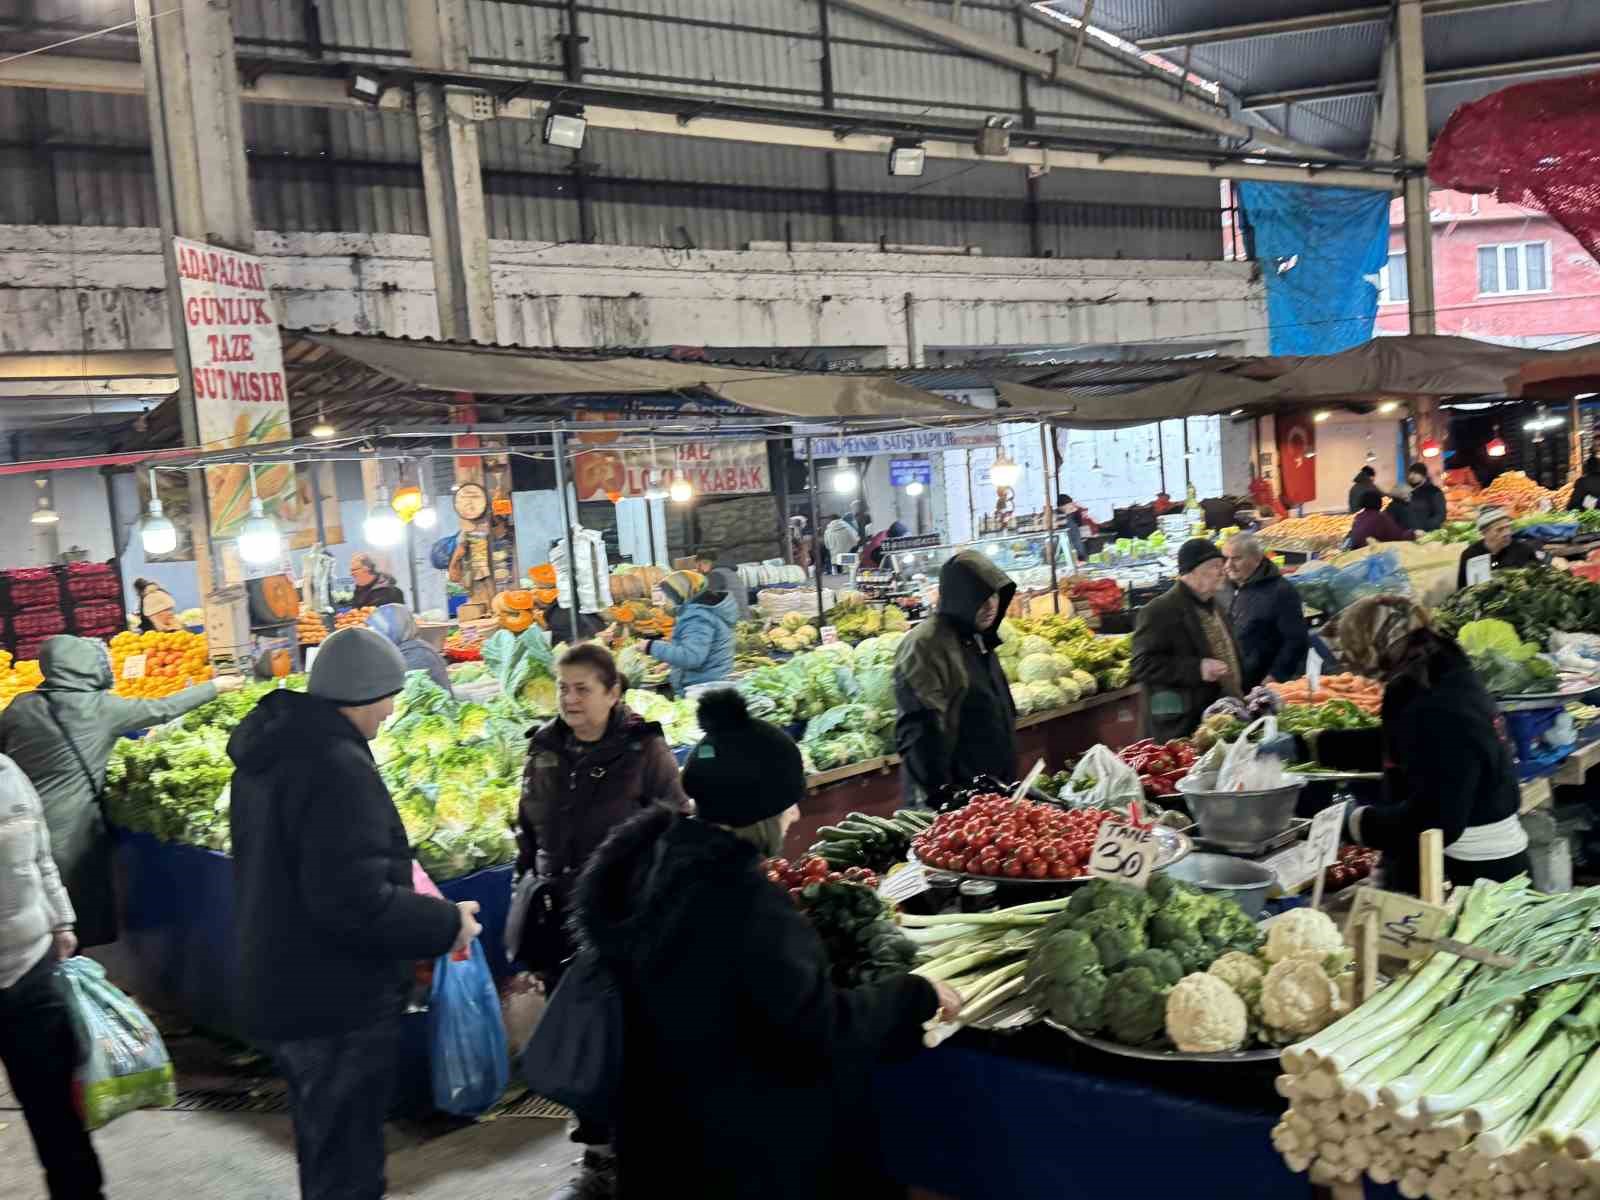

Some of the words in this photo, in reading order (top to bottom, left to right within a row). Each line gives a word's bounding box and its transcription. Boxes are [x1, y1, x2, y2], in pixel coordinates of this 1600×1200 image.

[179, 247, 265, 291] ADAPAZARI
[207, 334, 255, 363] TAZE
[228, 370, 285, 403] MISIR
[699, 465, 763, 493] KABAK
[1096, 841, 1144, 878] 30
